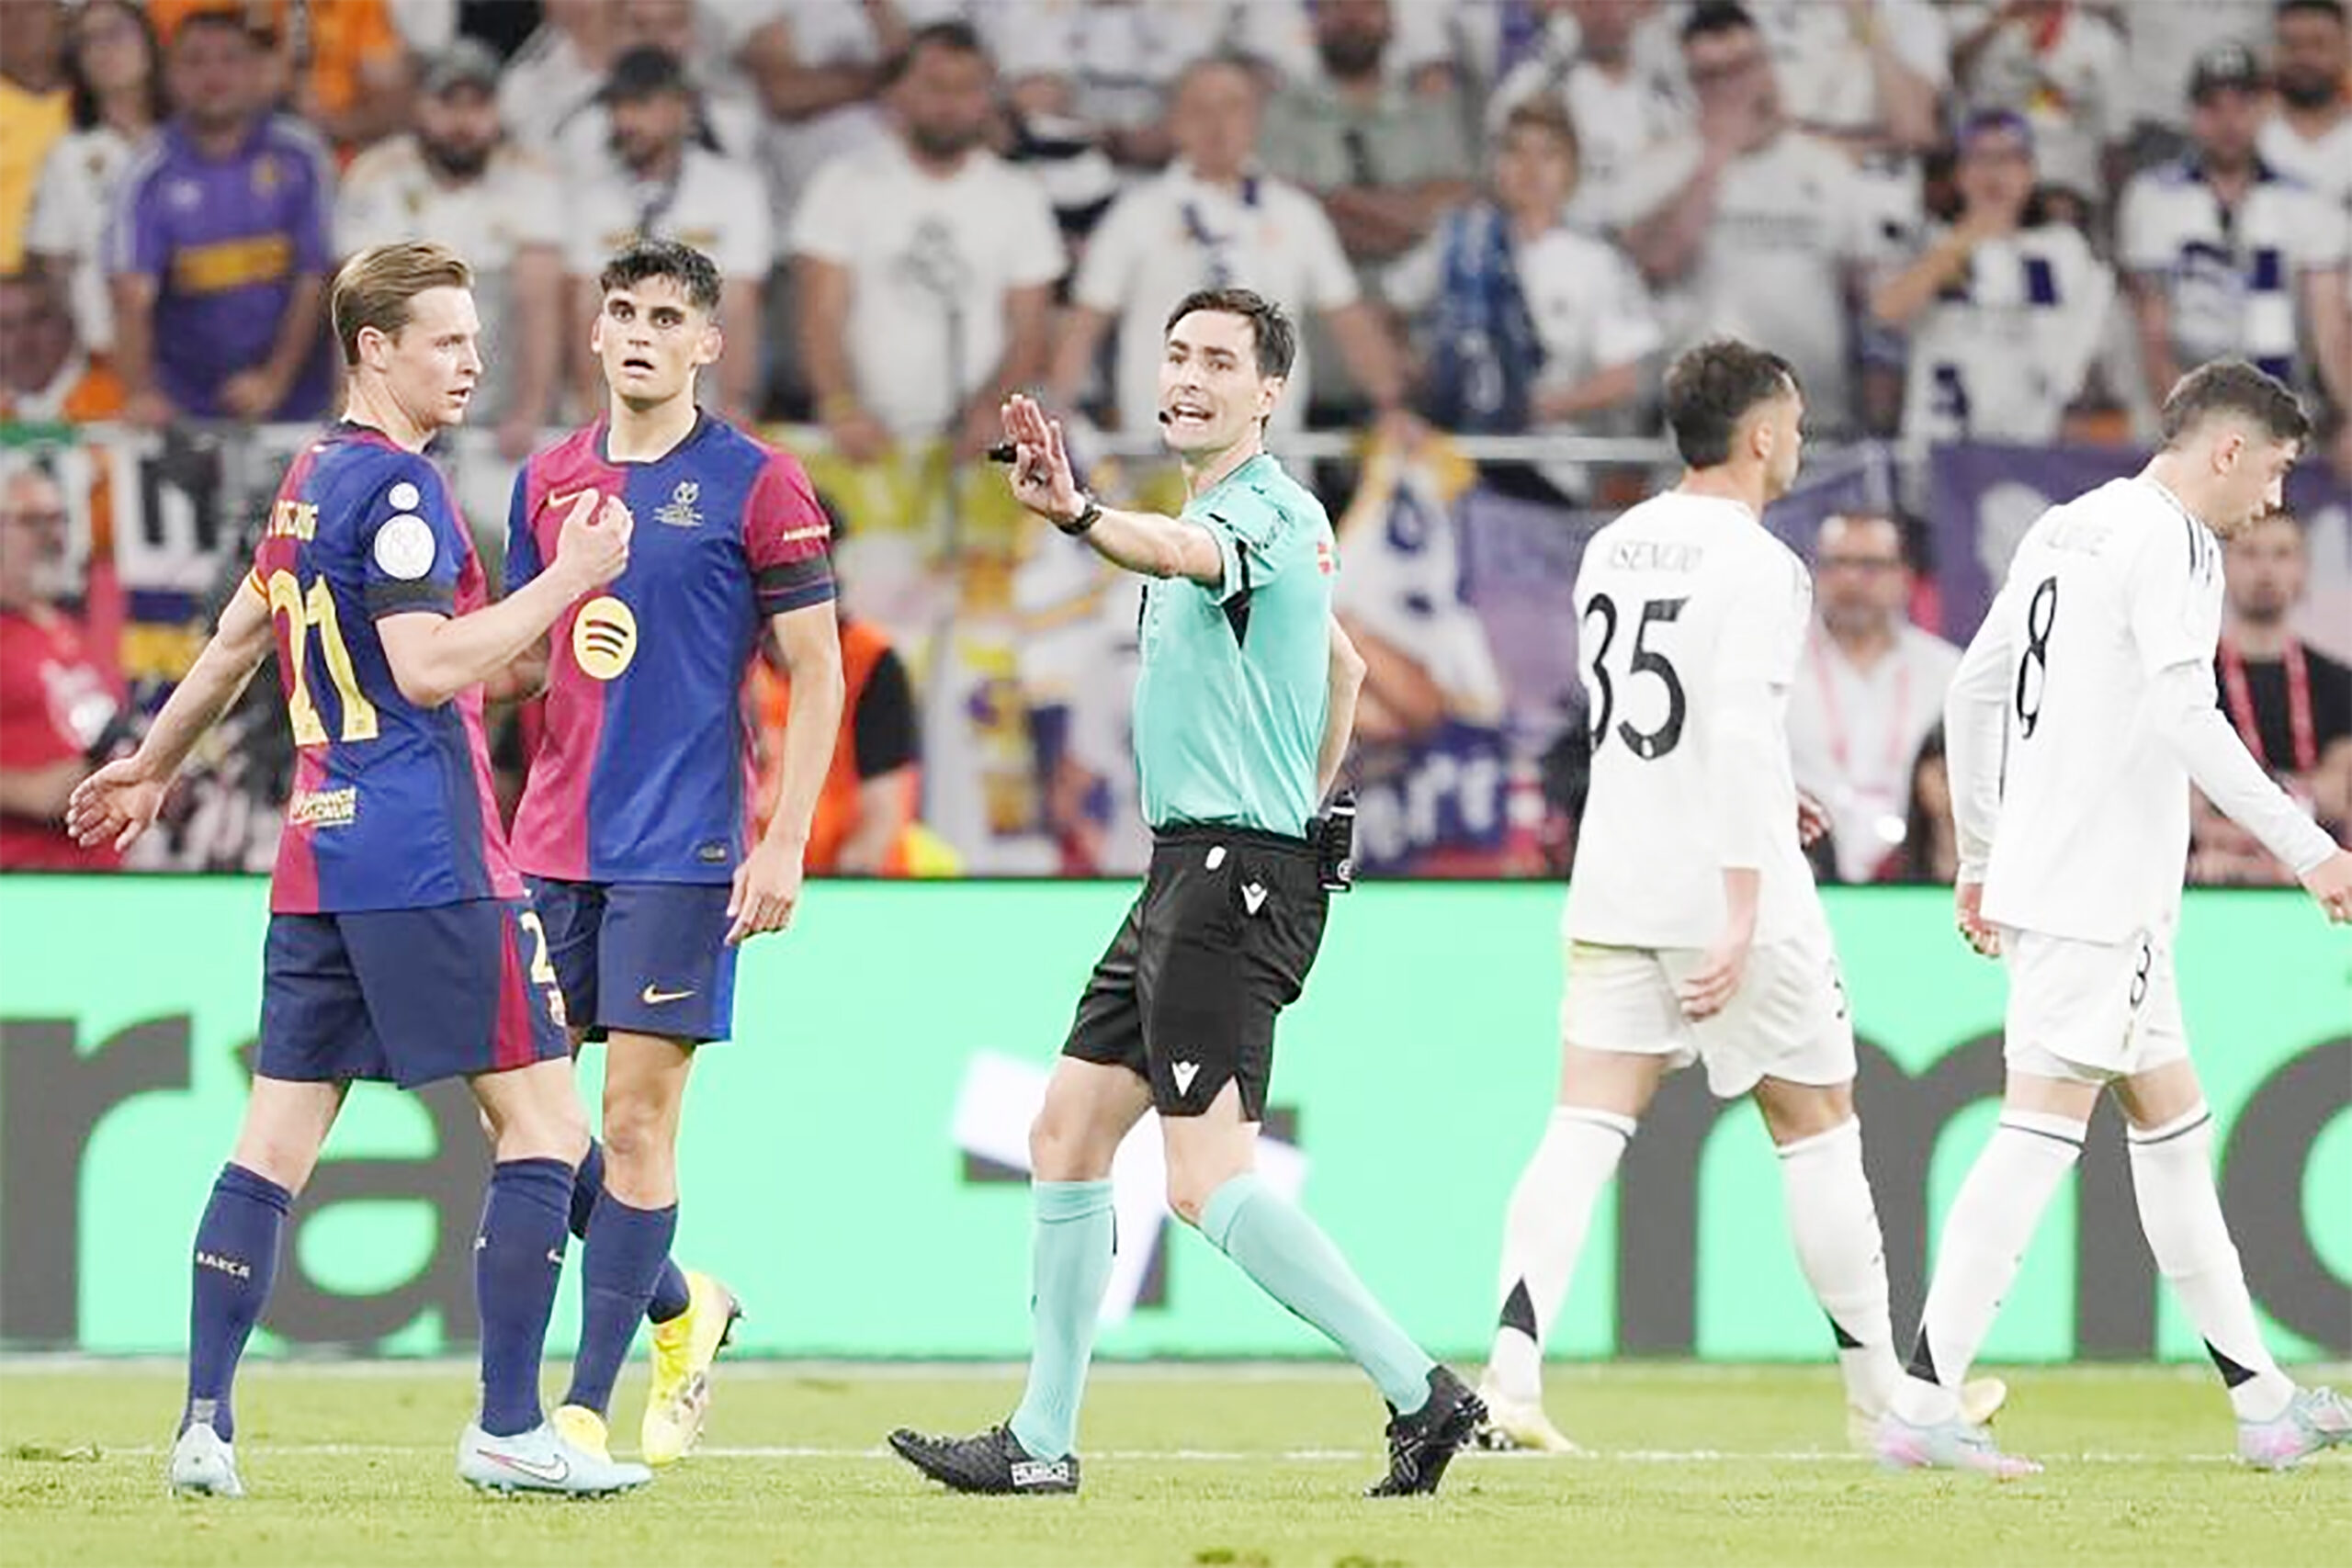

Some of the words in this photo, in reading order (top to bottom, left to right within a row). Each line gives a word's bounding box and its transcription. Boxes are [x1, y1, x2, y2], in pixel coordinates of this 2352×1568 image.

[268, 568, 379, 746] 21
[1584, 592, 1691, 761] 35
[2016, 574, 2058, 740] 8
[519, 911, 557, 983] 2
[2130, 942, 2152, 1012] 8
